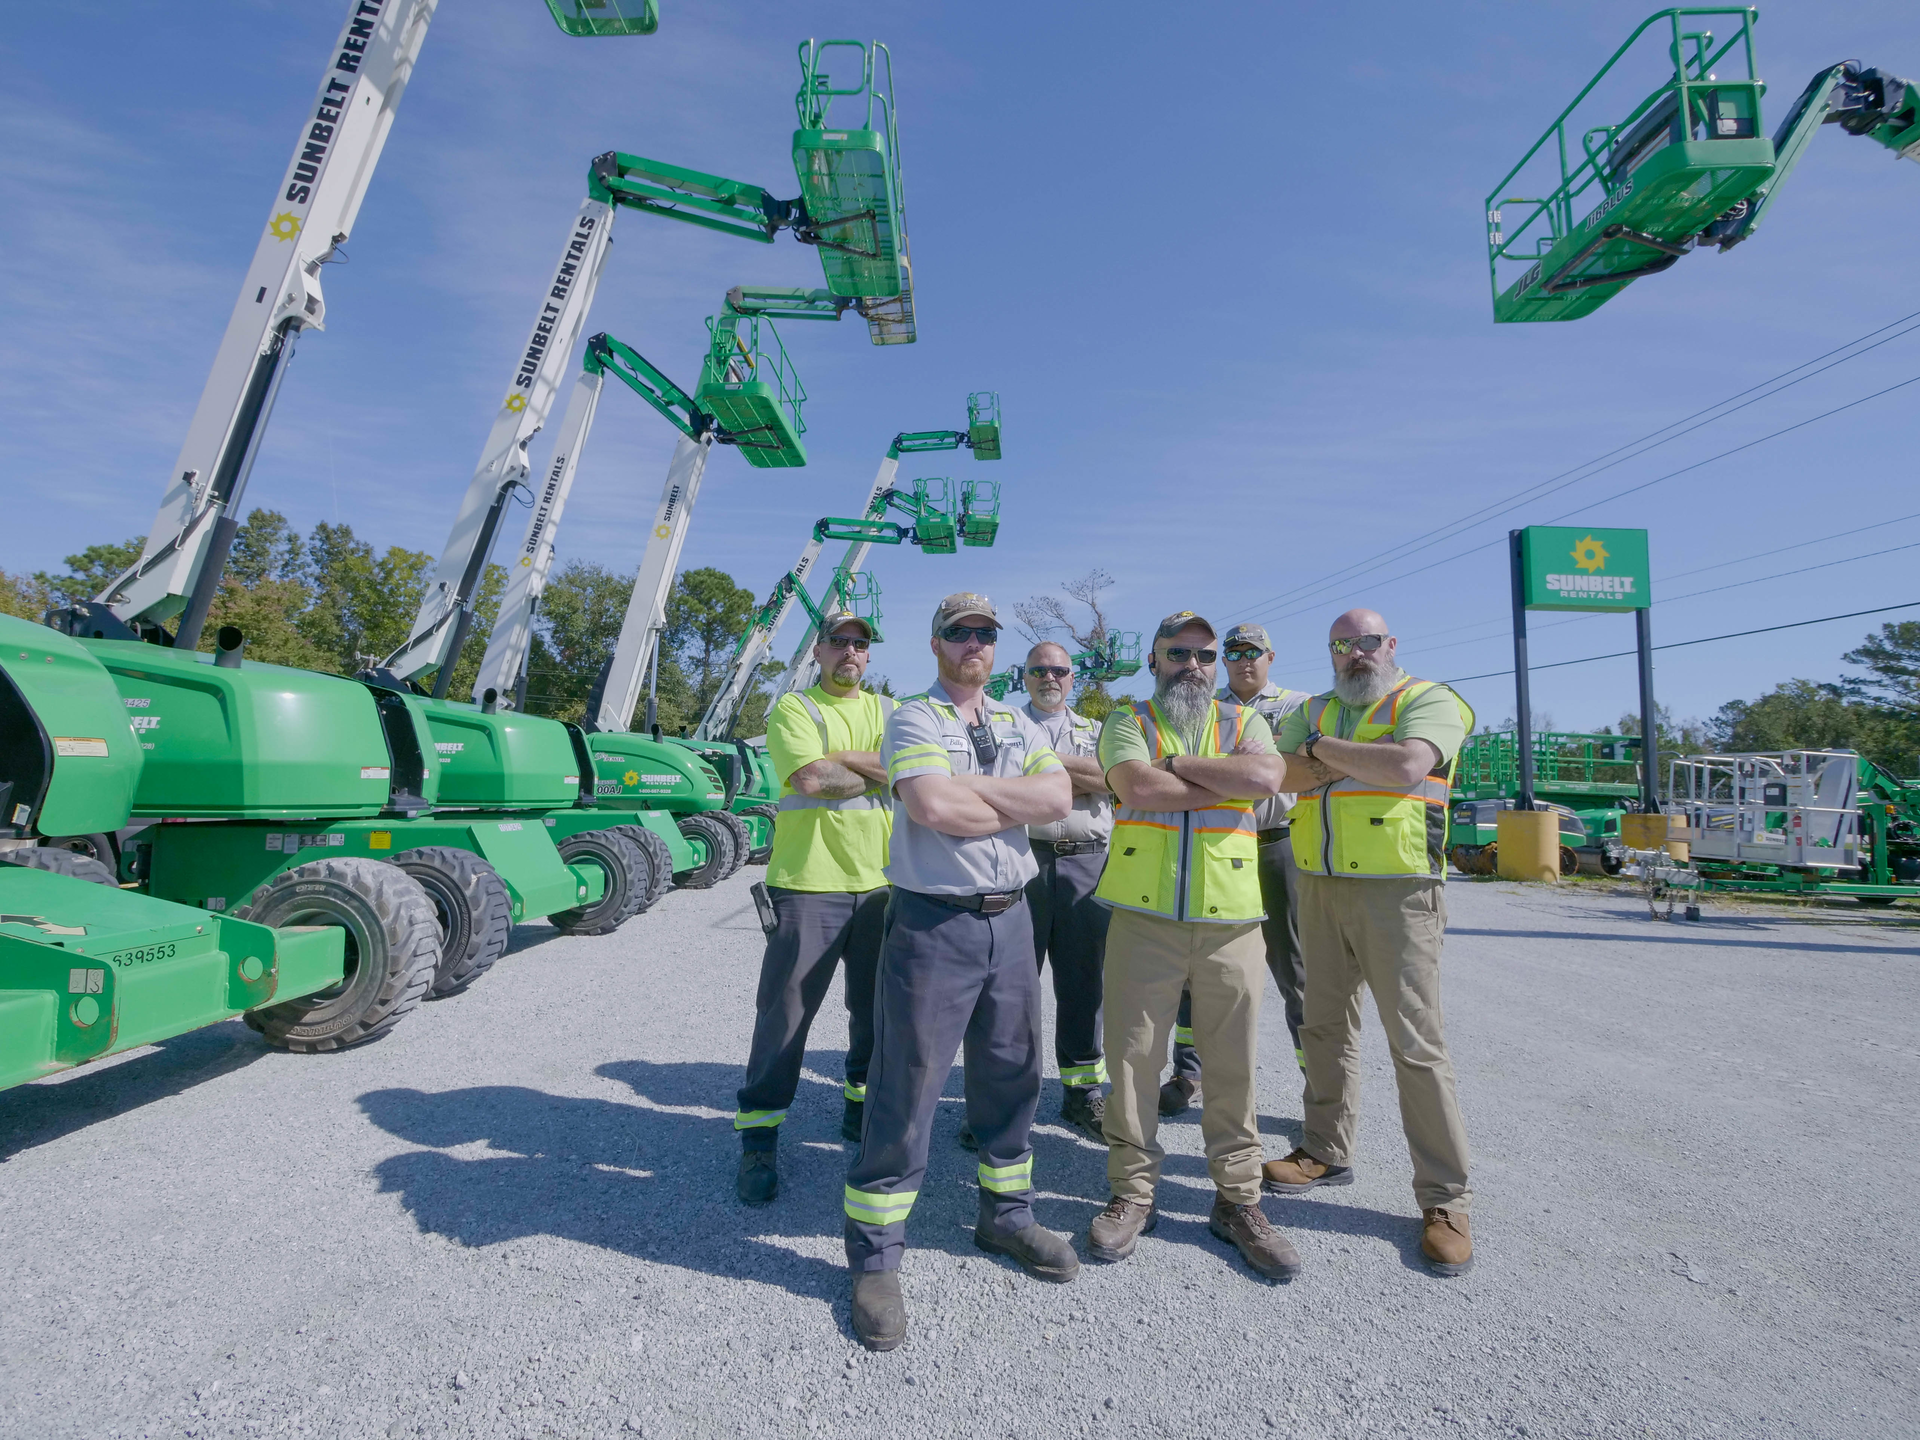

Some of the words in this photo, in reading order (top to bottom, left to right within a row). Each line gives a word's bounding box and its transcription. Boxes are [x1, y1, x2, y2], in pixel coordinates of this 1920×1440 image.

[286, 77, 352, 205] SUNBELT
[336, 0, 384, 74] RENT
[1585, 178, 1634, 232] JibPLUS
[1514, 262, 1542, 301] JLG
[516, 302, 560, 389] SUNBELT
[550, 215, 596, 301] RENTALS
[526, 506, 548, 554] SUNBELT
[543, 456, 565, 504] RENTALS
[664, 484, 680, 522] SUNBELT
[1546, 574, 1634, 593] SUNBELT
[1560, 591, 1624, 599] RENTALS
[641, 774, 681, 782] SUNBELT
